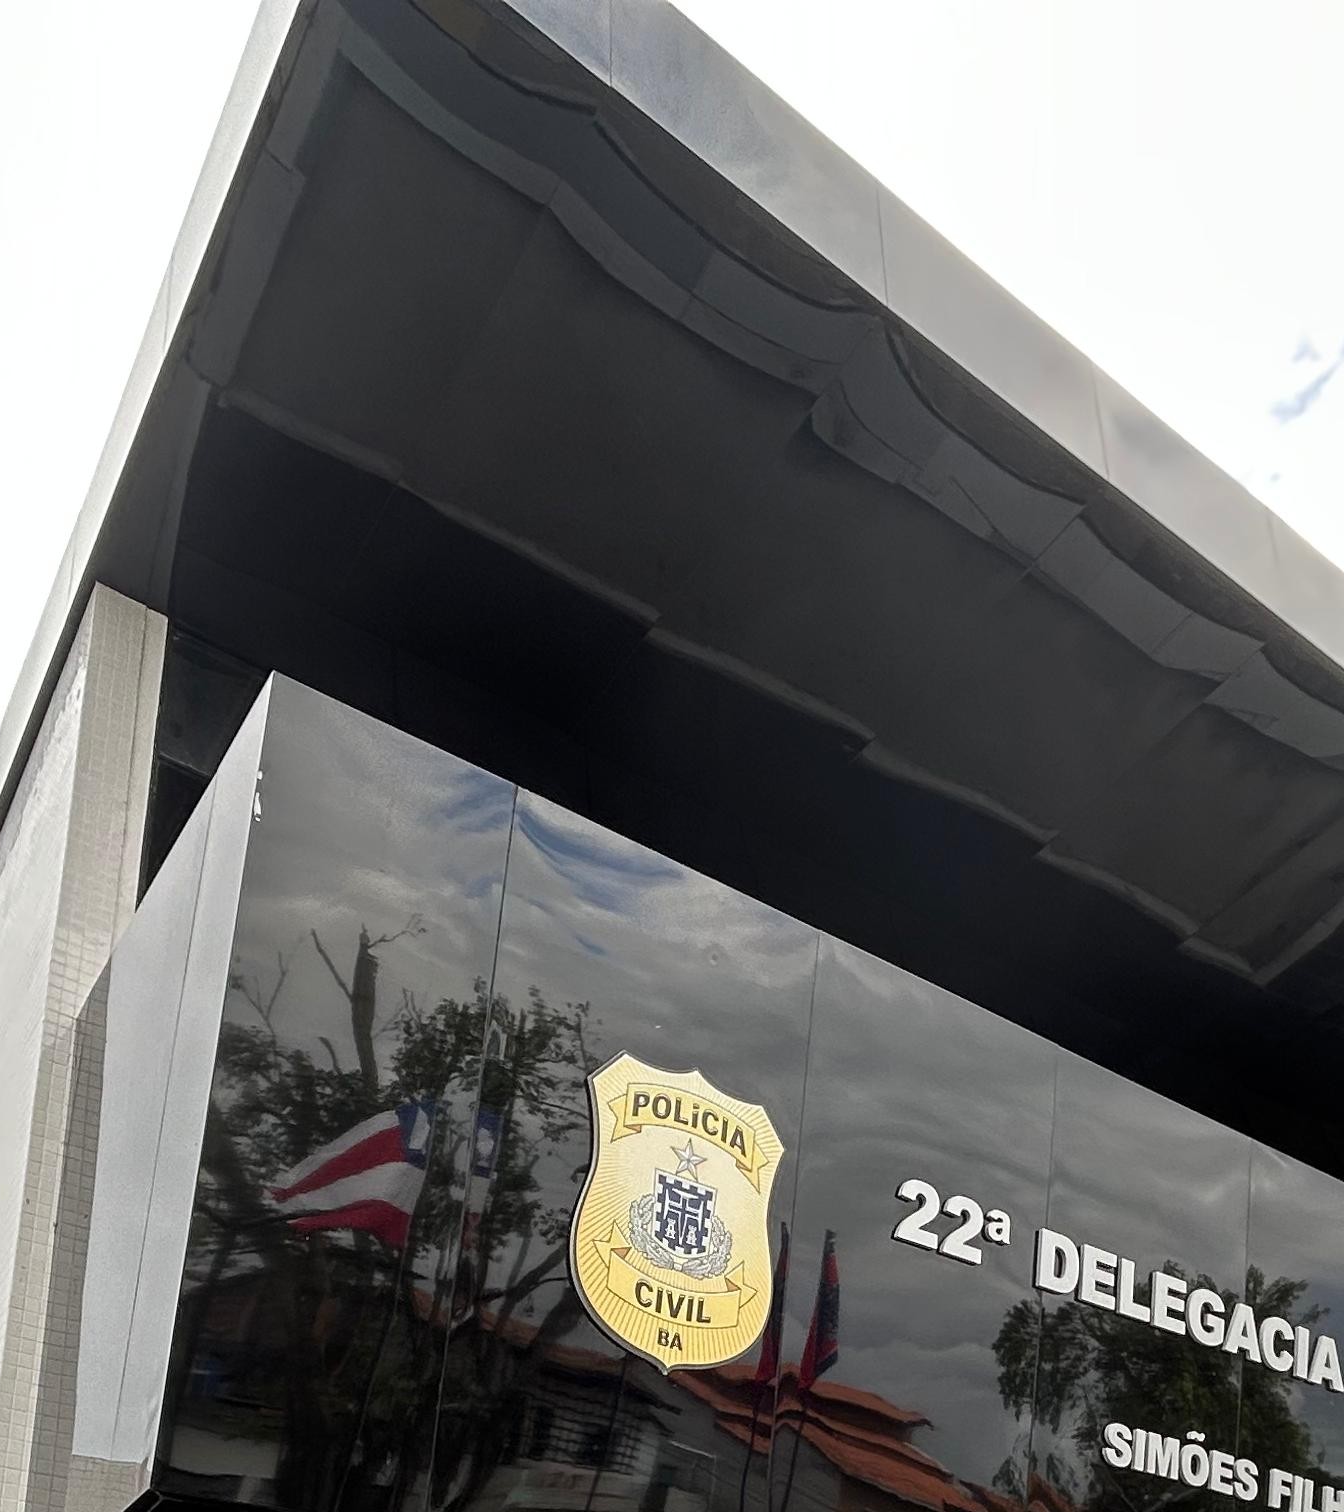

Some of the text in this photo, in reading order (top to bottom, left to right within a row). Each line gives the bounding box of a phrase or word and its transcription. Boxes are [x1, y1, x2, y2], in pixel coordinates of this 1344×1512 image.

[635, 1279, 711, 1323] CIVIL
[657, 1329, 684, 1352] BA
[1101, 1421, 1260, 1502] SIMÕES
